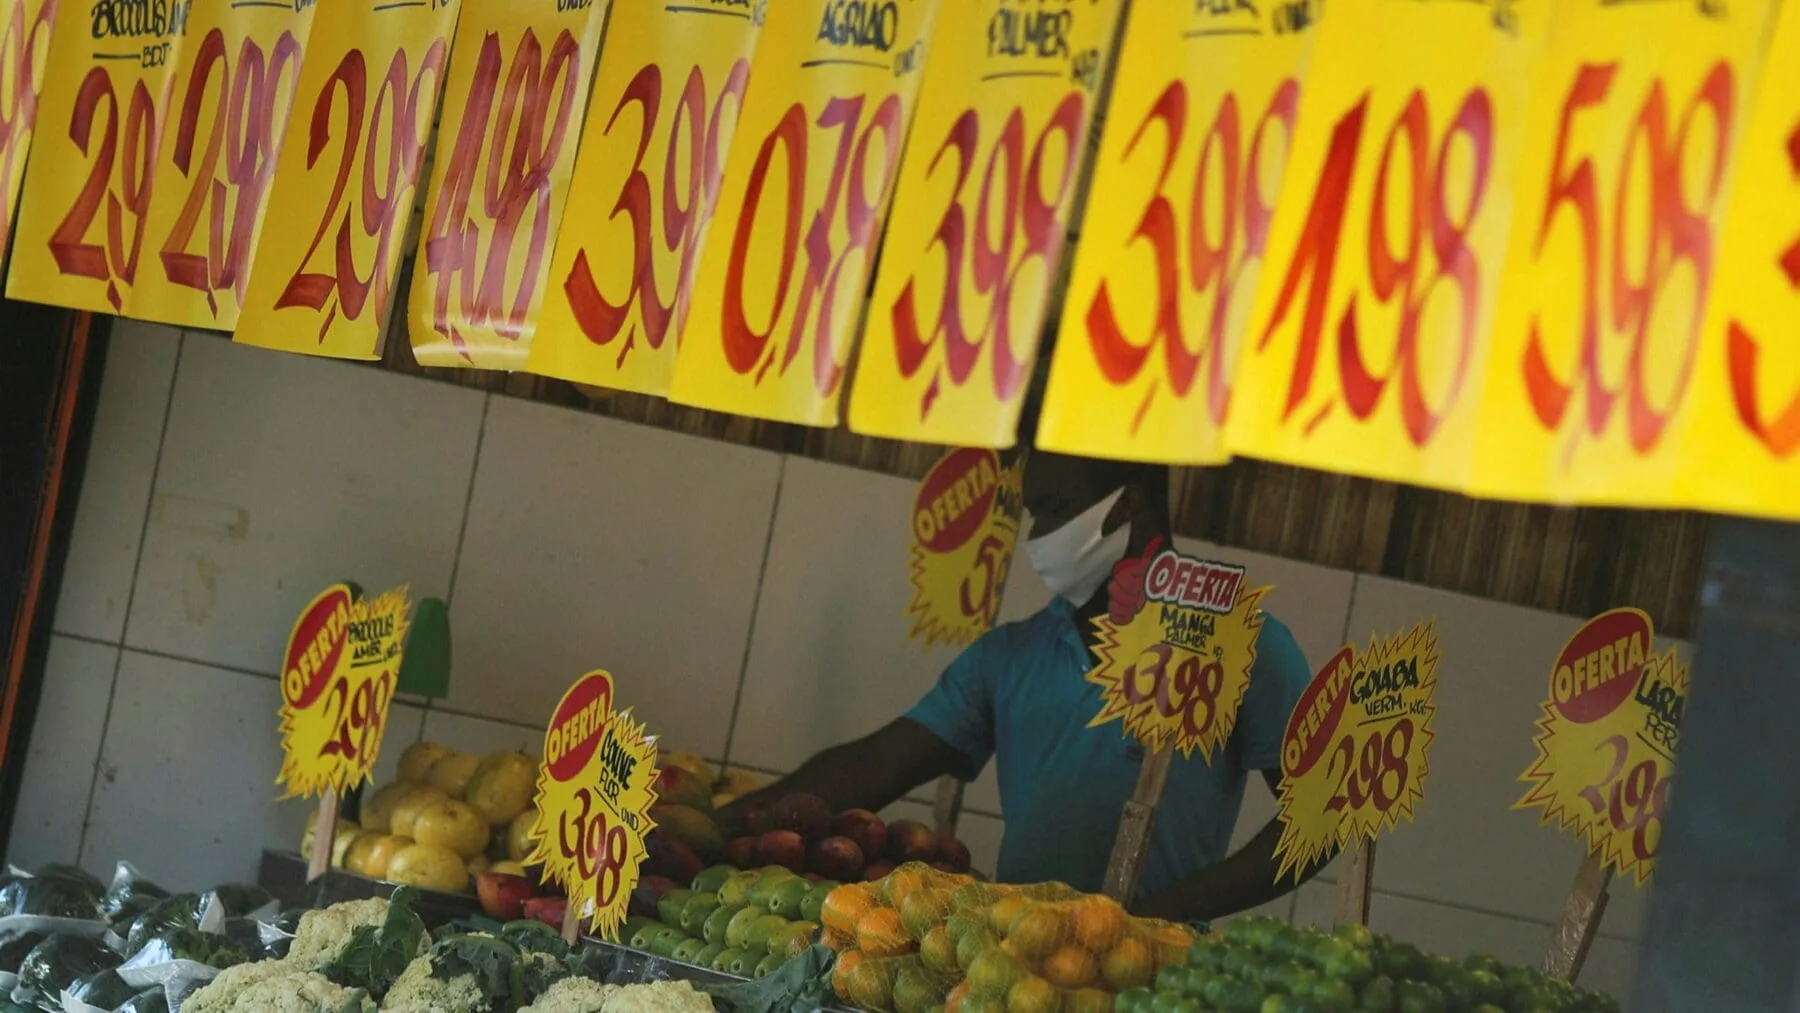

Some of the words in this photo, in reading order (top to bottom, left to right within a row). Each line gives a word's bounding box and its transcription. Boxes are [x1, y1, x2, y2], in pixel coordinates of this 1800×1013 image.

[1256, 86, 1494, 448] 1,98
[917, 457, 996, 542] OFERTA
[1147, 553, 1243, 609] OFERTA
[286, 600, 349, 703] OFERTA
[1160, 605, 1215, 637] MANGA
[1350, 655, 1419, 705] GOIABA
[1553, 631, 1647, 704] OFERTA
[550, 692, 607, 766] OFERTA
[1284, 657, 1351, 771] OFERTA
[599, 767, 620, 806] FLOR
[600, 729, 637, 792] COUVE
